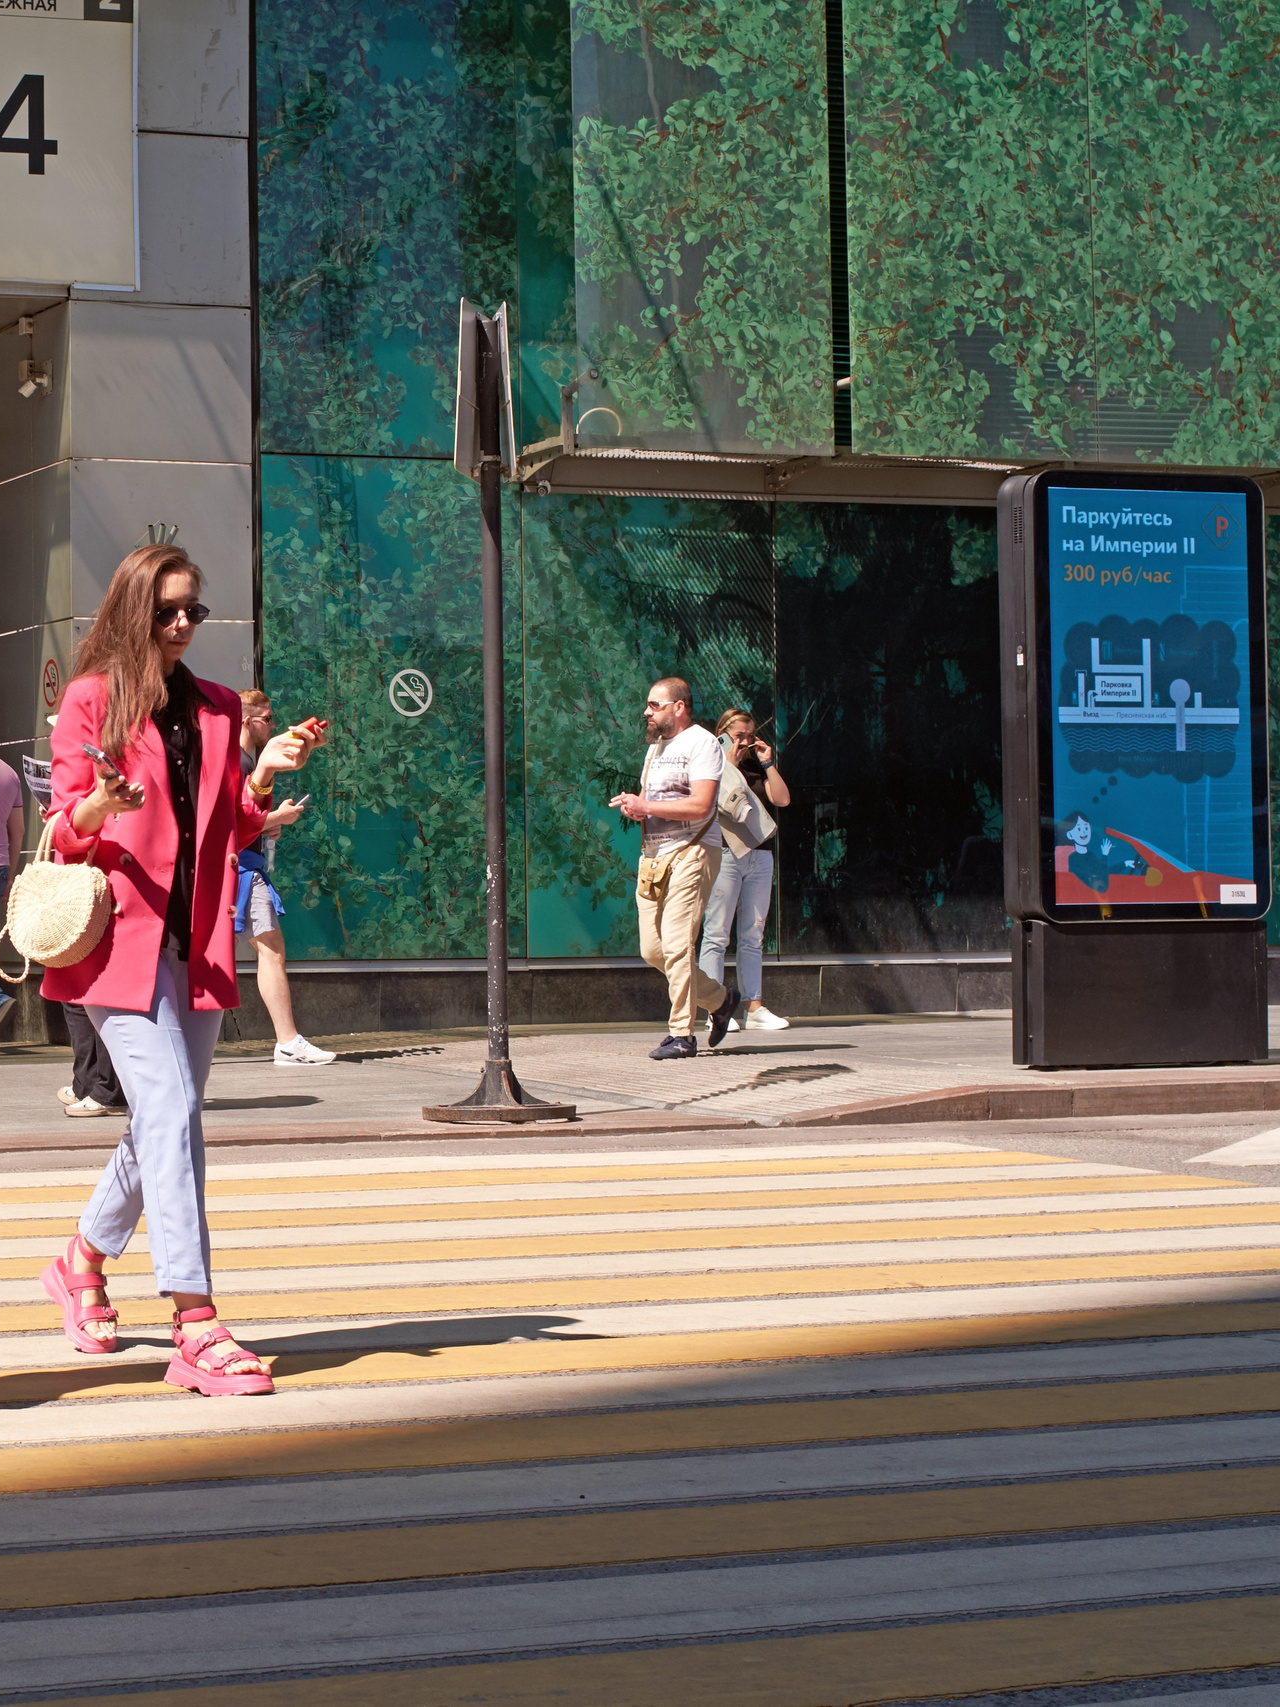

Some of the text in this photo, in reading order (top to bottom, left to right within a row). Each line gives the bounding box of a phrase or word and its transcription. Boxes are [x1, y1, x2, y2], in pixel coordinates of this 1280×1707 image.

[1062, 505, 1173, 529] Паркуйтесь
[1062, 535, 1195, 557] на Империи II
[1063, 565, 1172, 587] 300 руб/час
[1100, 681, 1132, 689] Парковка
[1100, 690, 1130, 698] Империя
